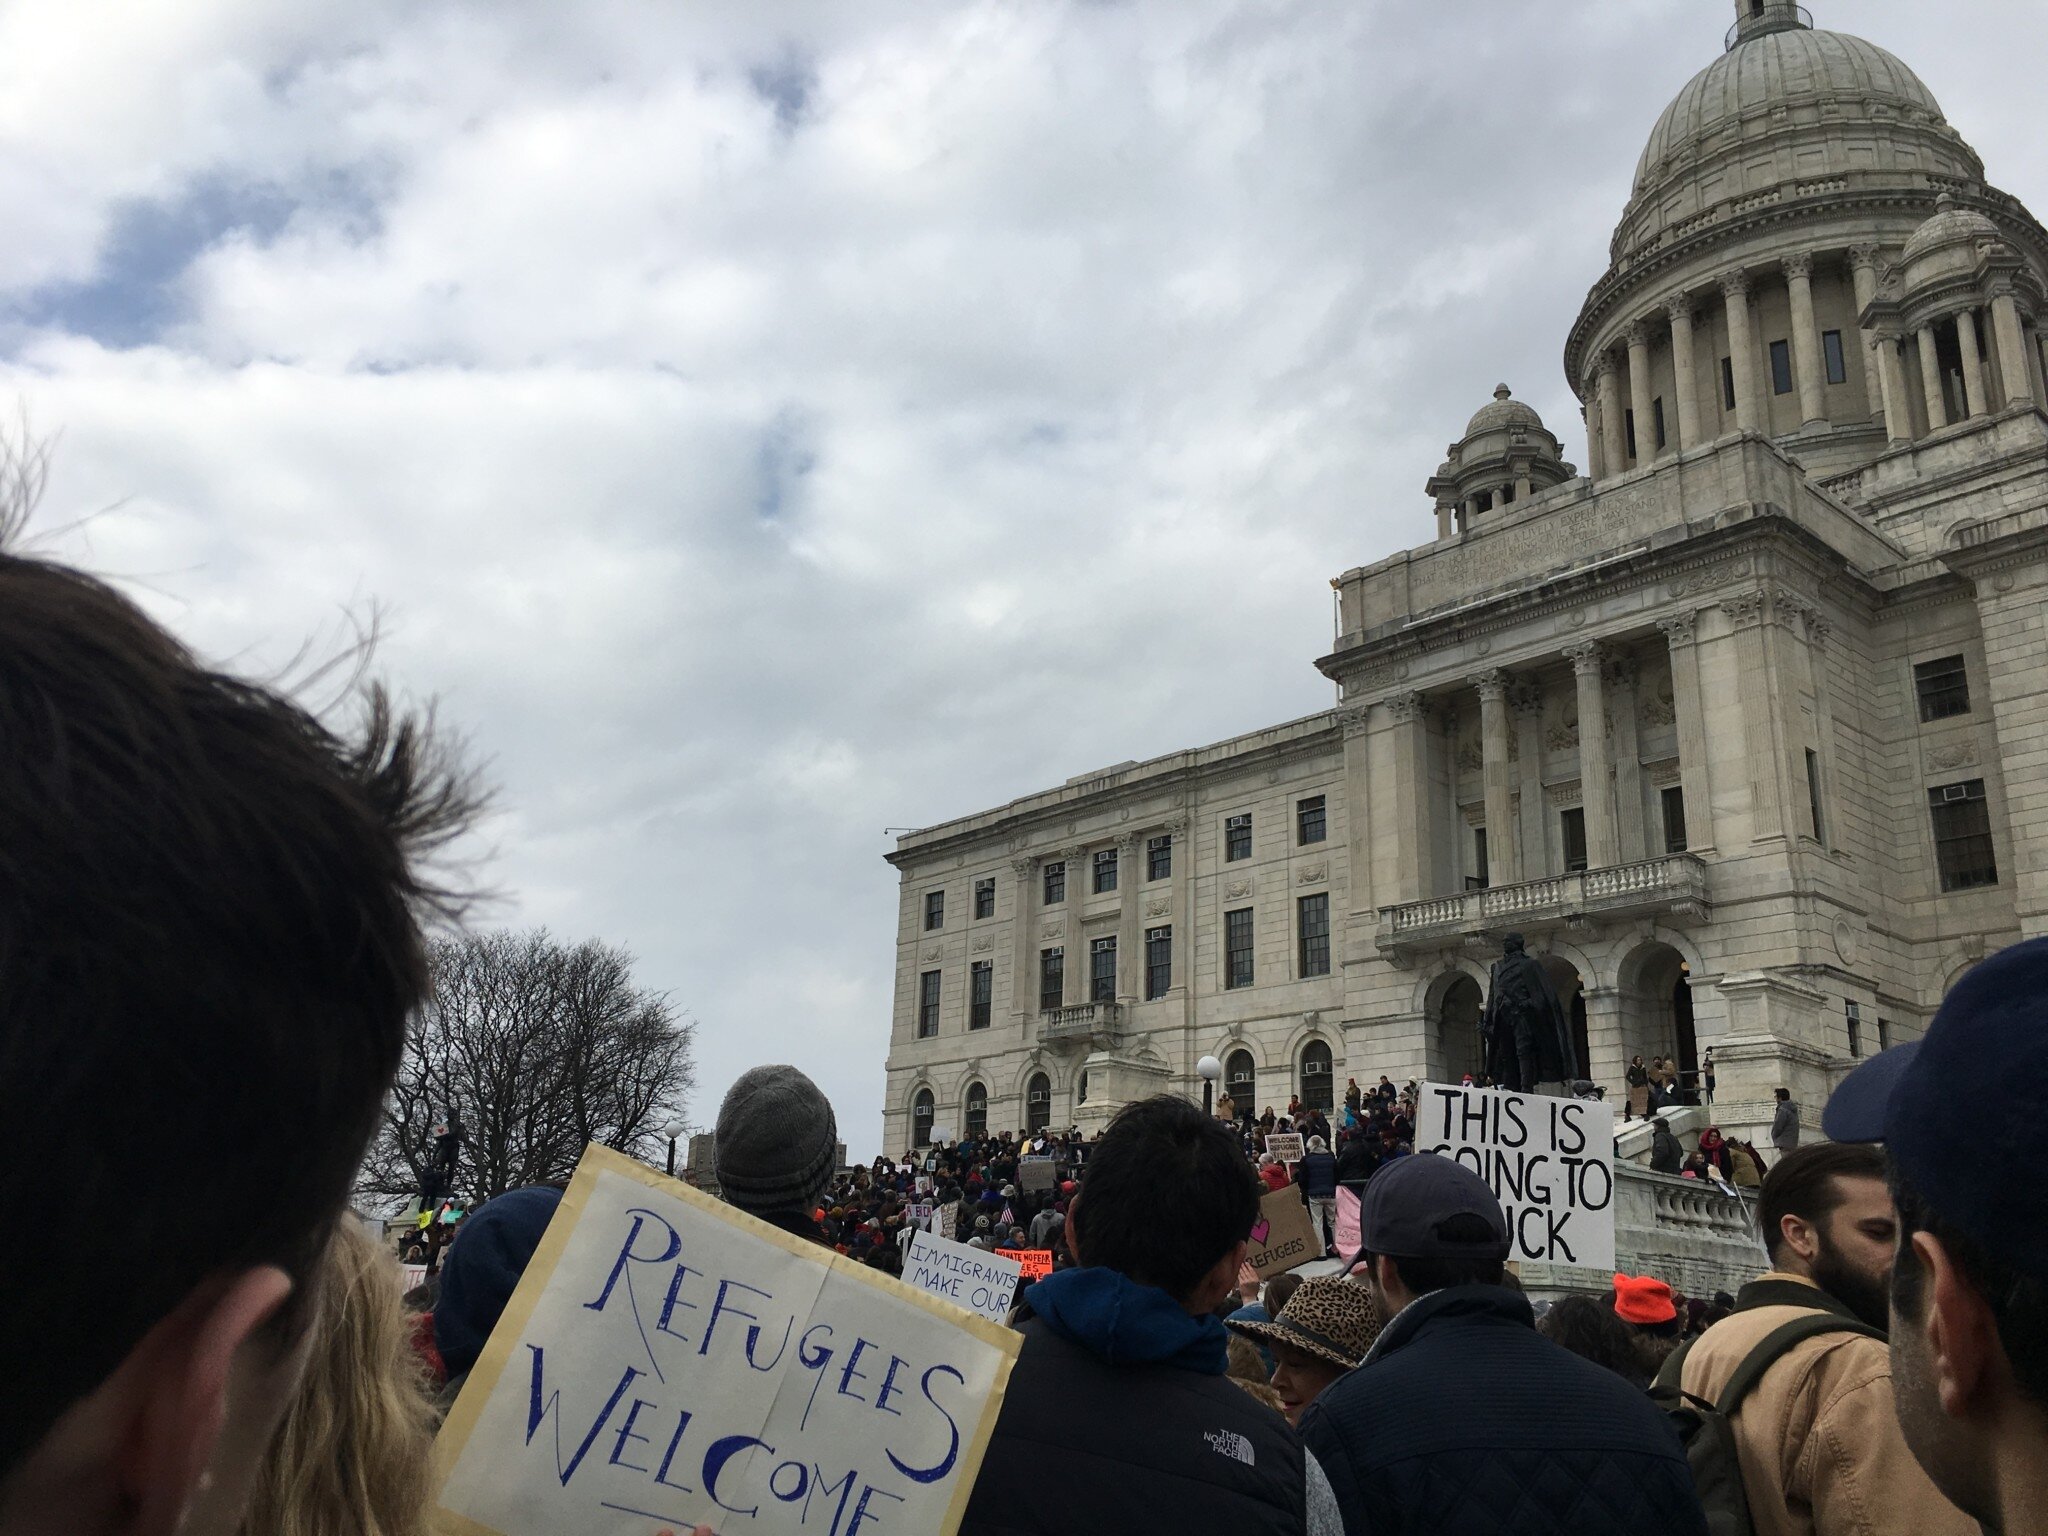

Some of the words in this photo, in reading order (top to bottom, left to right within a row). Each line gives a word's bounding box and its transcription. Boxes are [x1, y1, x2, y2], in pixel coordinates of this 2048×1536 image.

[1414, 572, 1436, 588] THAT
[1473, 537, 1536, 567] FLOURISHING
[1540, 528, 1564, 544] CIVIL
[1568, 516, 1596, 535] STATE
[1602, 508, 1621, 522] MAY
[1625, 496, 1656, 515] STAND
[1432, 558, 1444, 571] TO
[1450, 548, 1475, 565] HOLD
[1522, 520, 1554, 540] LIVELY
[1560, 491, 1631, 527] EXPERIMENT
[1599, 513, 1636, 533] LIBERTY
[1268, 1135, 1300, 1144] WELCOME
[1434, 1089, 1528, 1148] THIS
[1550, 1102, 1586, 1155] IS
[1269, 1143, 1301, 1151] REFUGEES
[1433, 1144, 1551, 1205] OING
[1560, 1157, 1612, 1211] TO
[1338, 1230, 1356, 1241] LOVE
[1507, 1205, 1576, 1263] UCK
[911, 1243, 1018, 1289] IMMIGRANTS
[1024, 1253, 1033, 1261] NO
[1034, 1254, 1050, 1264] FEAR
[1247, 1238, 1305, 1269] REFUGEES
[913, 1267, 963, 1298] MAKE
[971, 1287, 1010, 1313] OUR
[583, 1208, 964, 1484] REFUGEES
[526, 1344, 905, 1536] WELCOME
[1203, 1431, 1239, 1451] NORTH
[1213, 1443, 1239, 1460] FACE
[1220, 1429, 1240, 1442] THE
